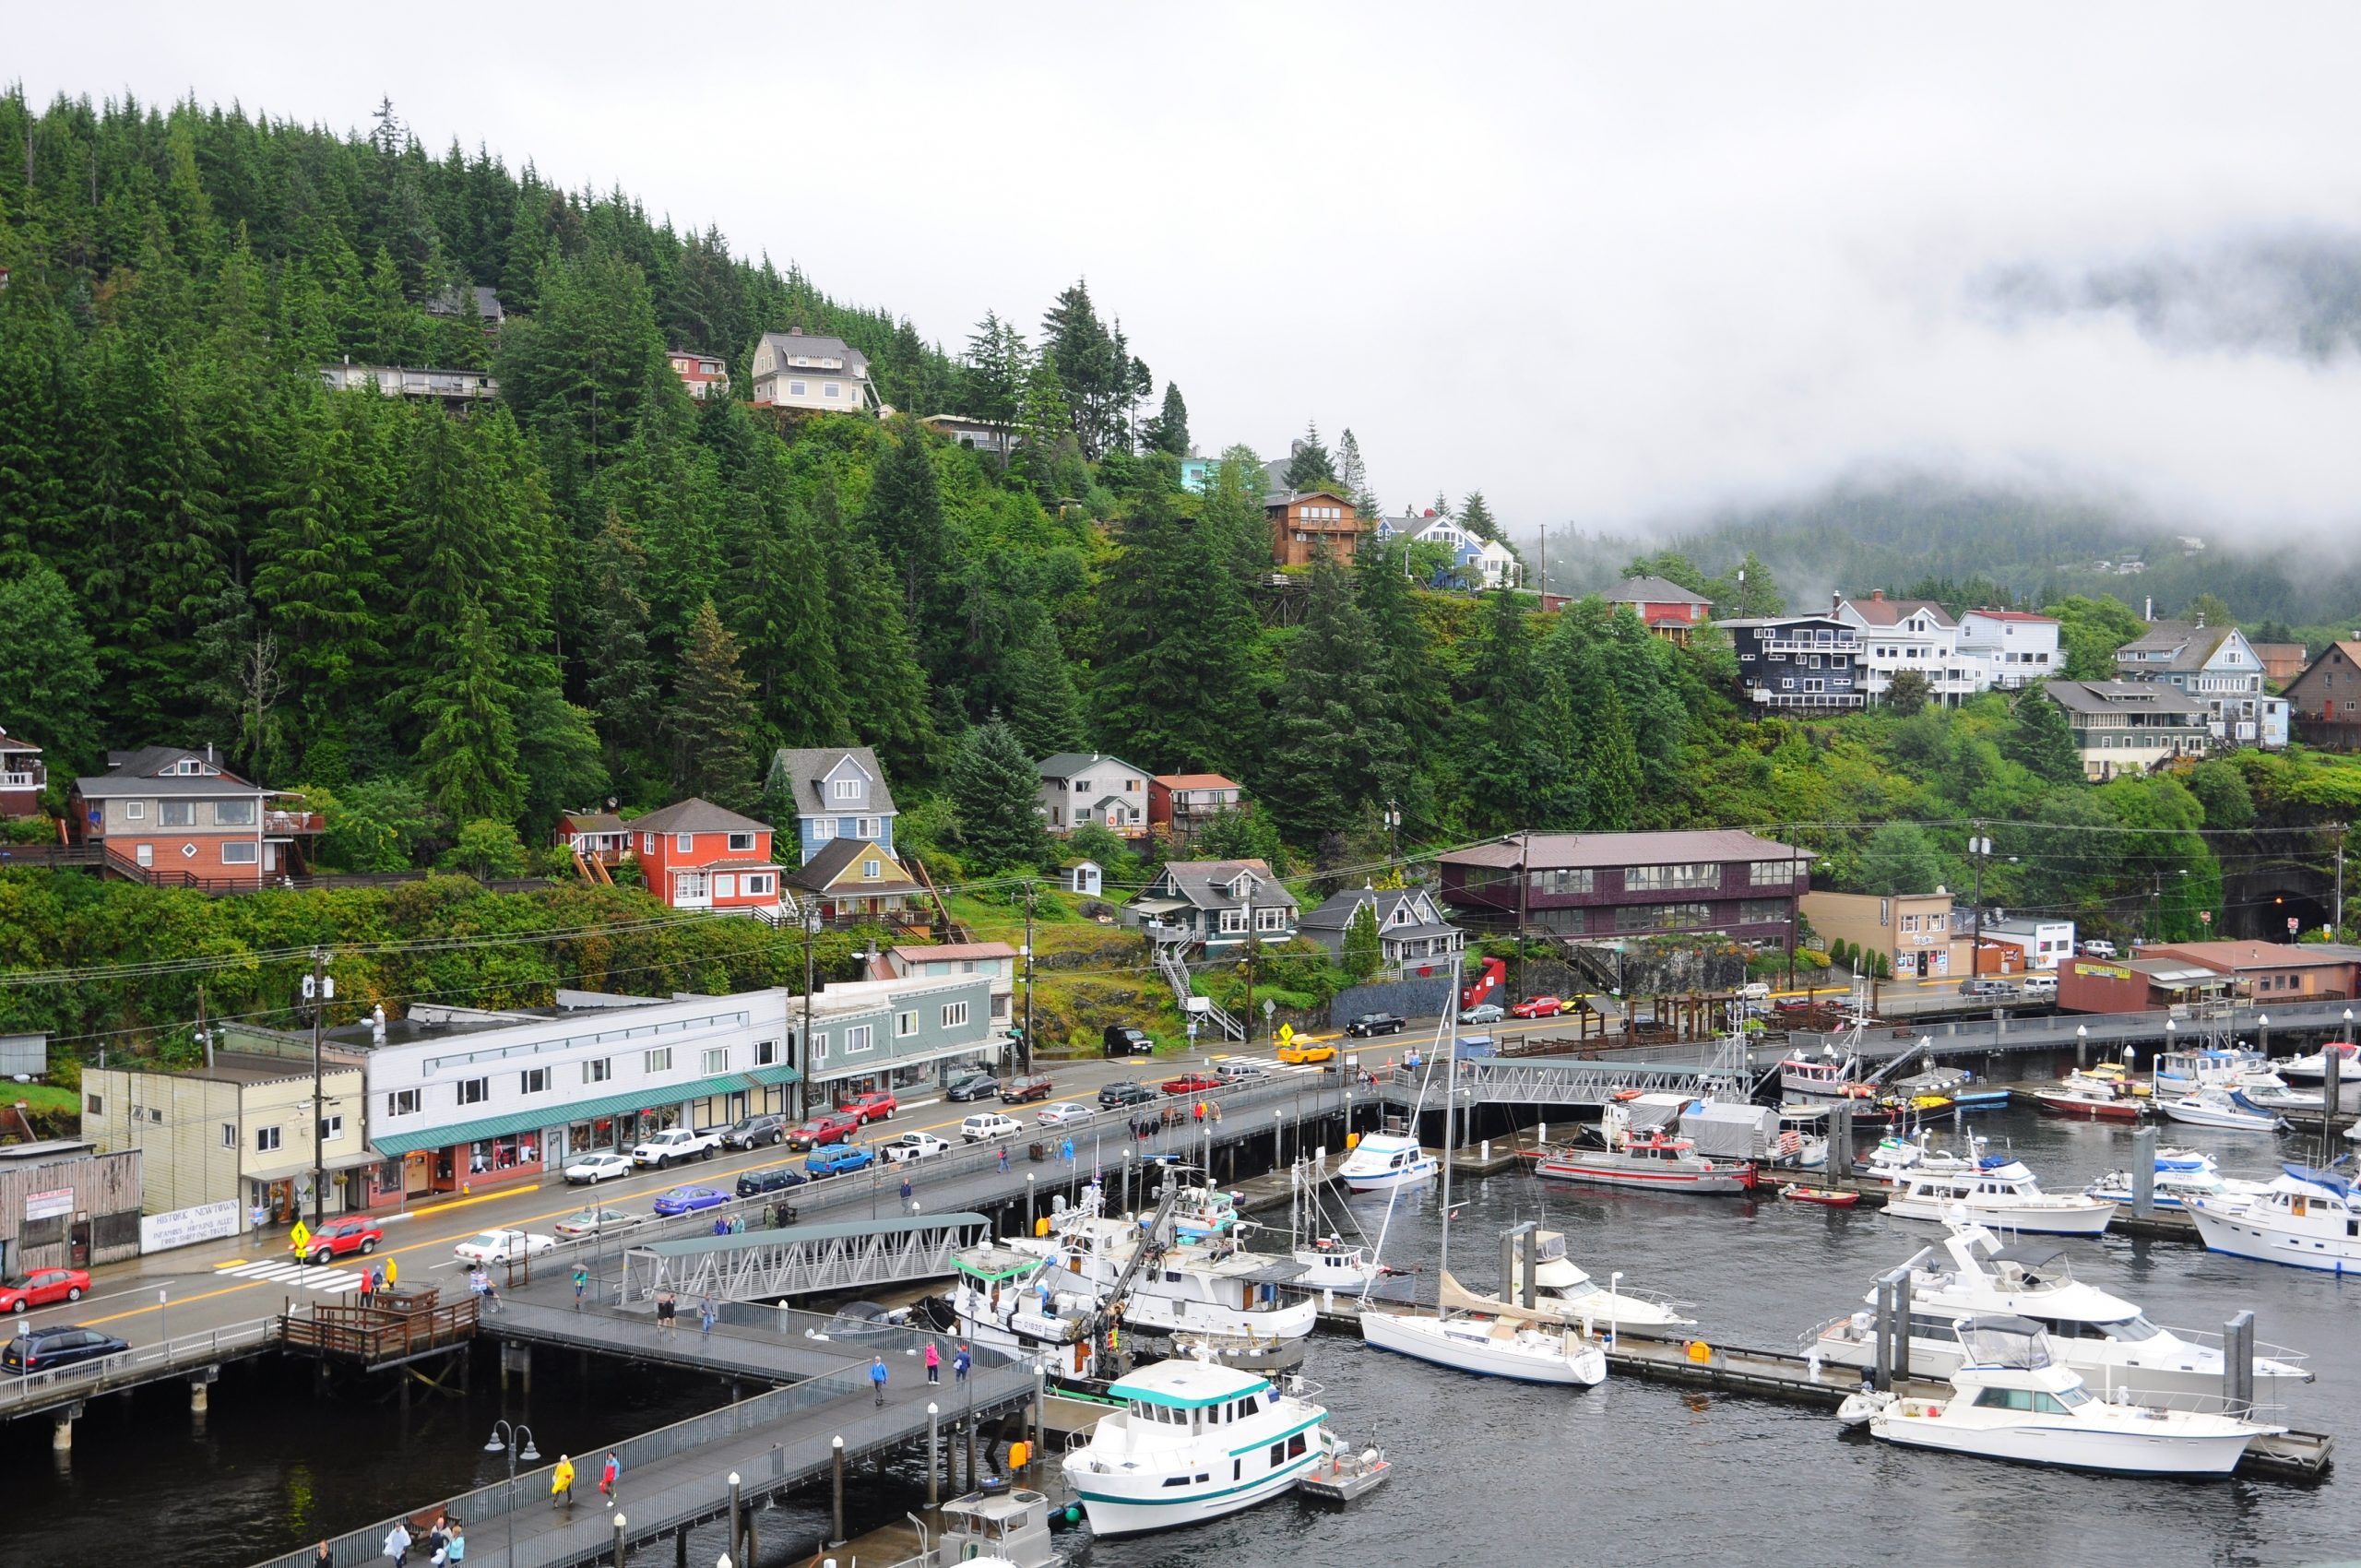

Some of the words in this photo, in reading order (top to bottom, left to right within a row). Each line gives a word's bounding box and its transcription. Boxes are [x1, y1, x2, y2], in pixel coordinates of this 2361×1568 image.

[2099, 967, 2130, 976] CHARTERS
[157, 1210, 188, 1225] HISTORIC
[195, 1202, 237, 1217] NEWTOWN
[154, 1228, 183, 1240] INFAMOUS
